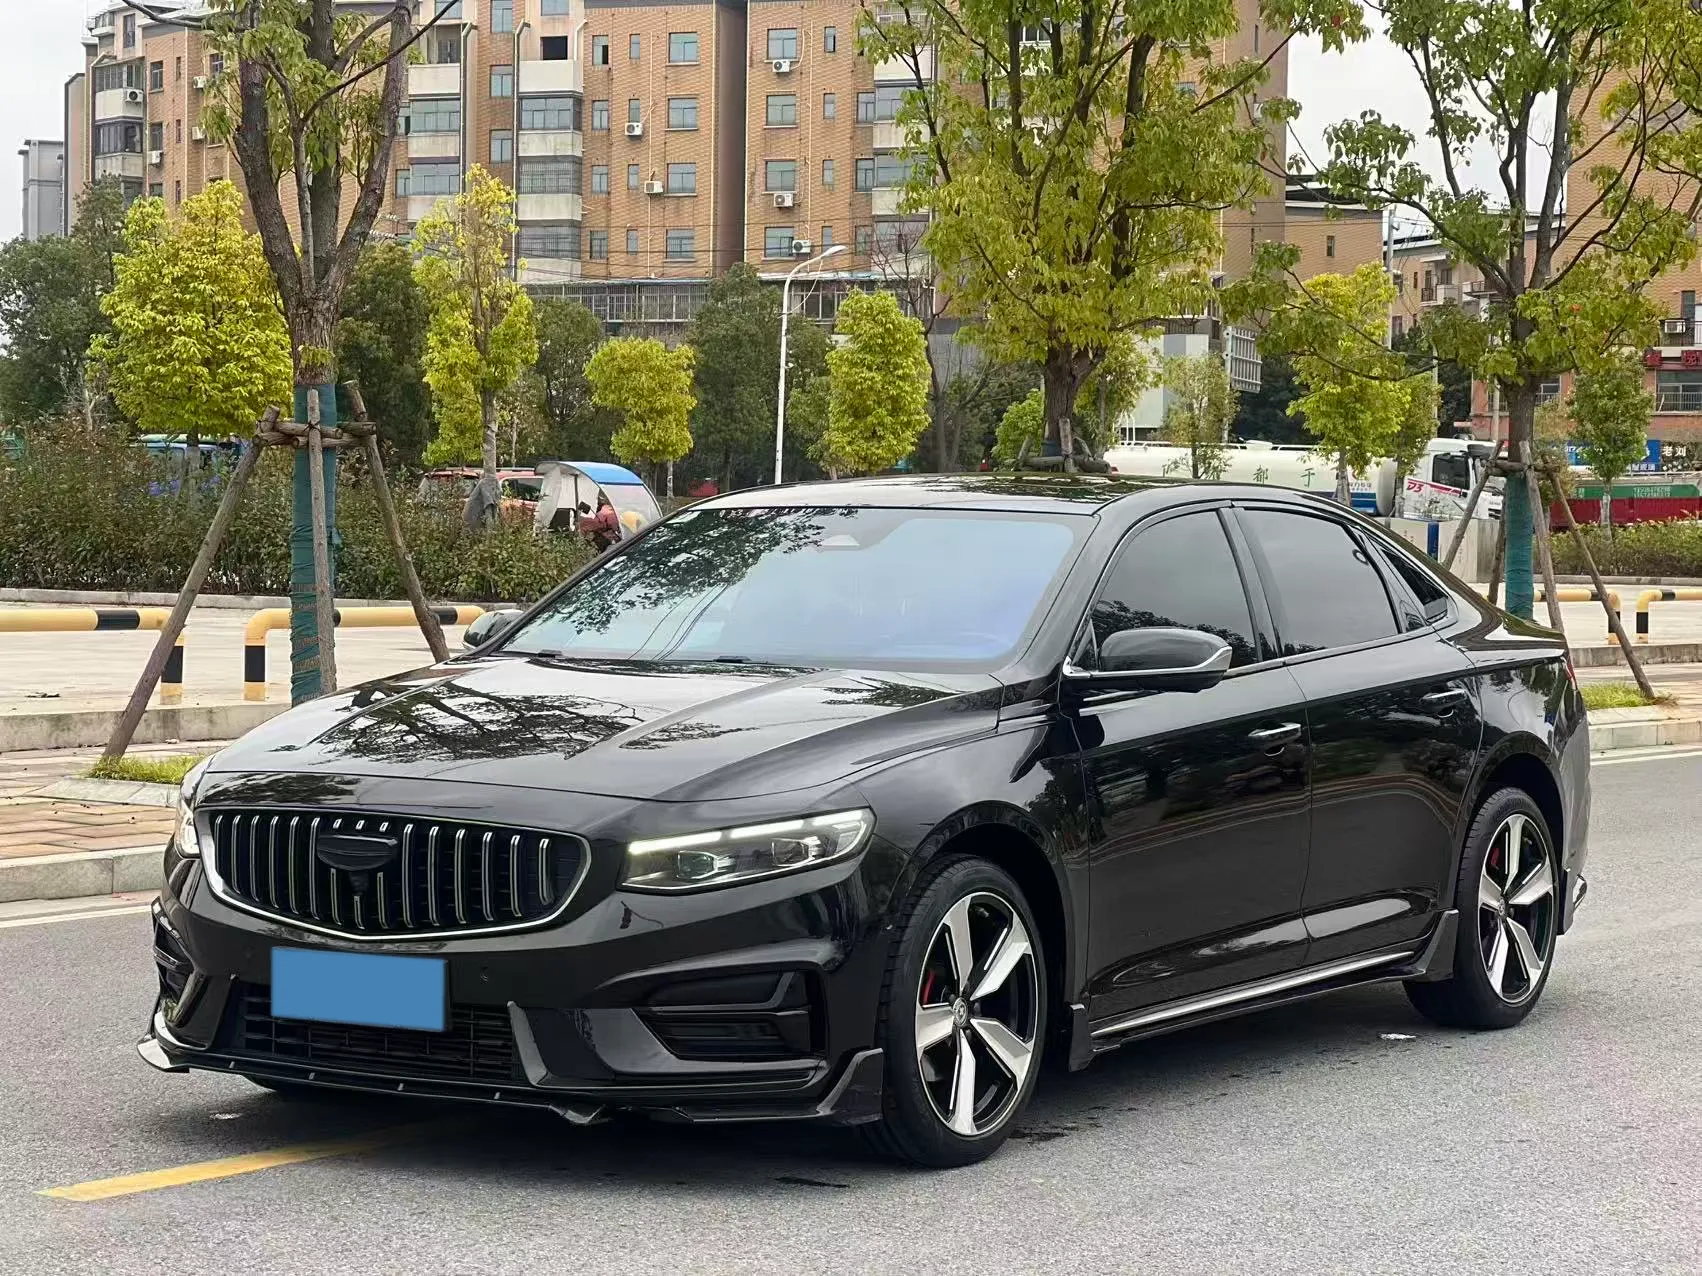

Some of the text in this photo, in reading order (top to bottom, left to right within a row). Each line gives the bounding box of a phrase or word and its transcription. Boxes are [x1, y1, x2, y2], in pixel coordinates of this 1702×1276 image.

[1662, 445, 1687, 457] 老刘
[1253, 465, 1269, 485] 都
[1407, 480, 1425, 493] D3
